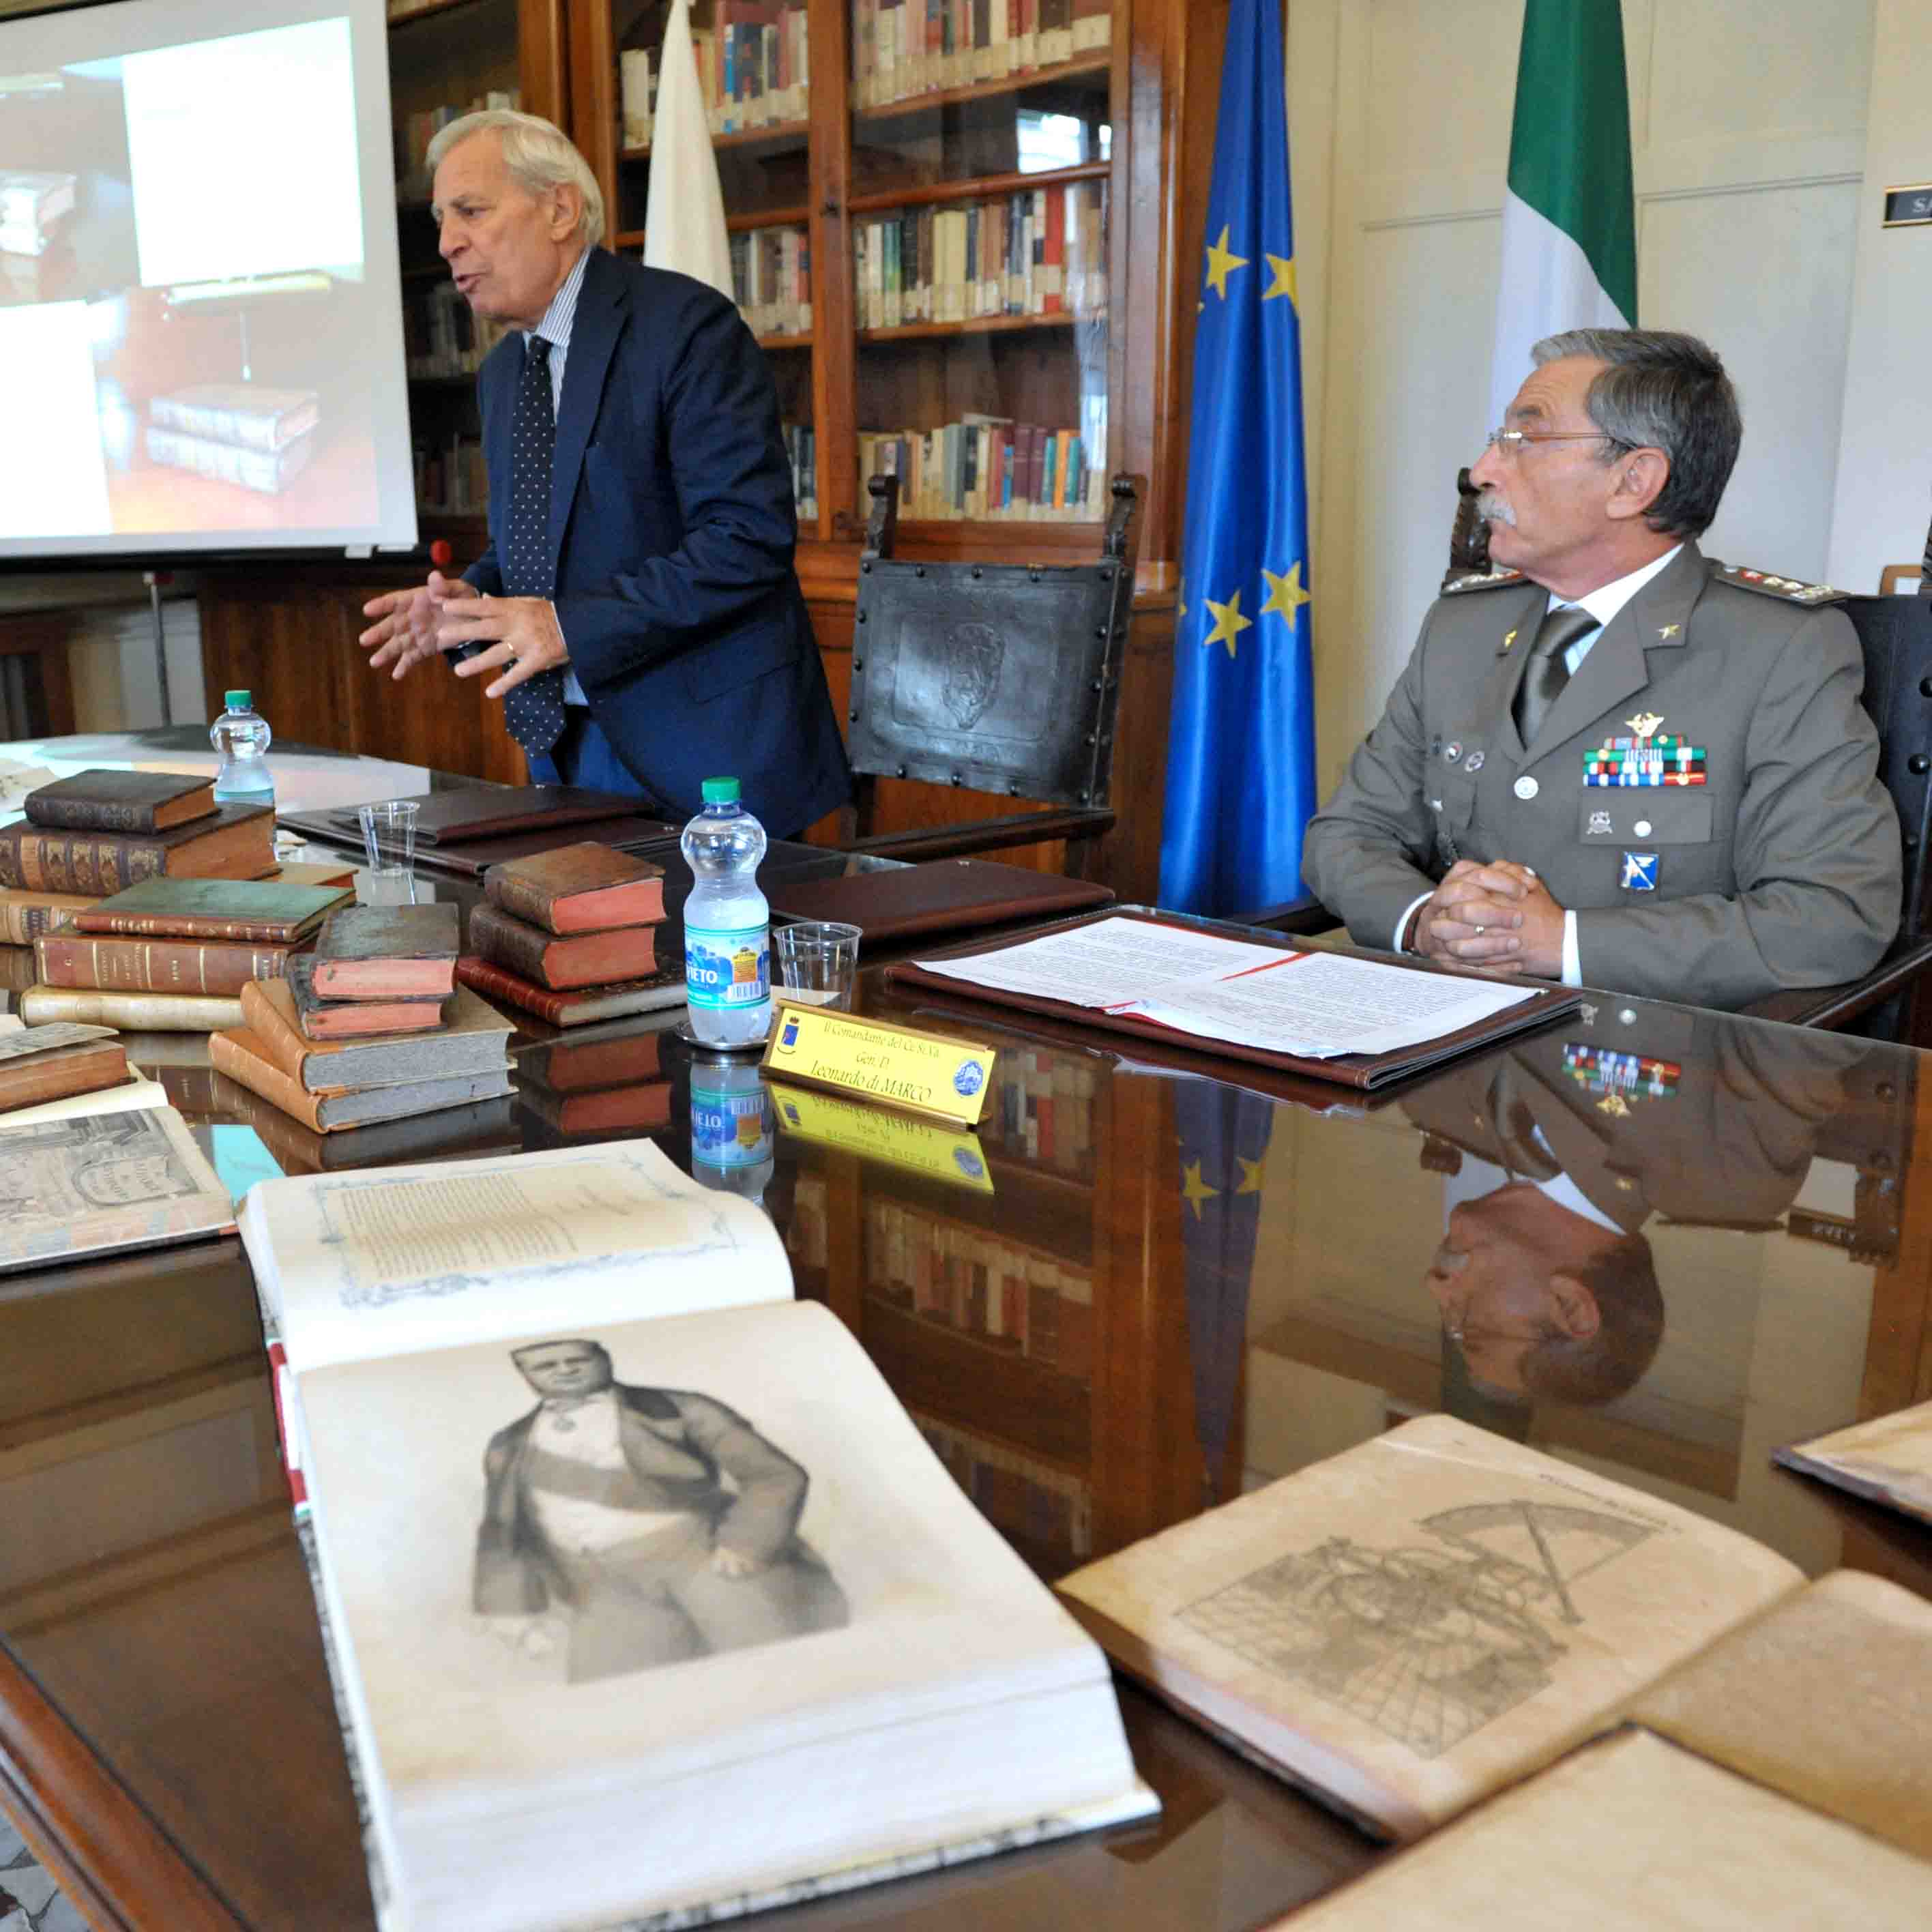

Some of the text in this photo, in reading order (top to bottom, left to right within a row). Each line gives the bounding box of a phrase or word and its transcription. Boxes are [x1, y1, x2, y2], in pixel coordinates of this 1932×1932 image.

[832, 1023, 886, 1046] Comandante
[888, 1036, 902, 1049] del
[810, 1059, 865, 1087] Leonardo
[866, 1074, 879, 1091] di
[881, 1078, 932, 1102] MARCO
